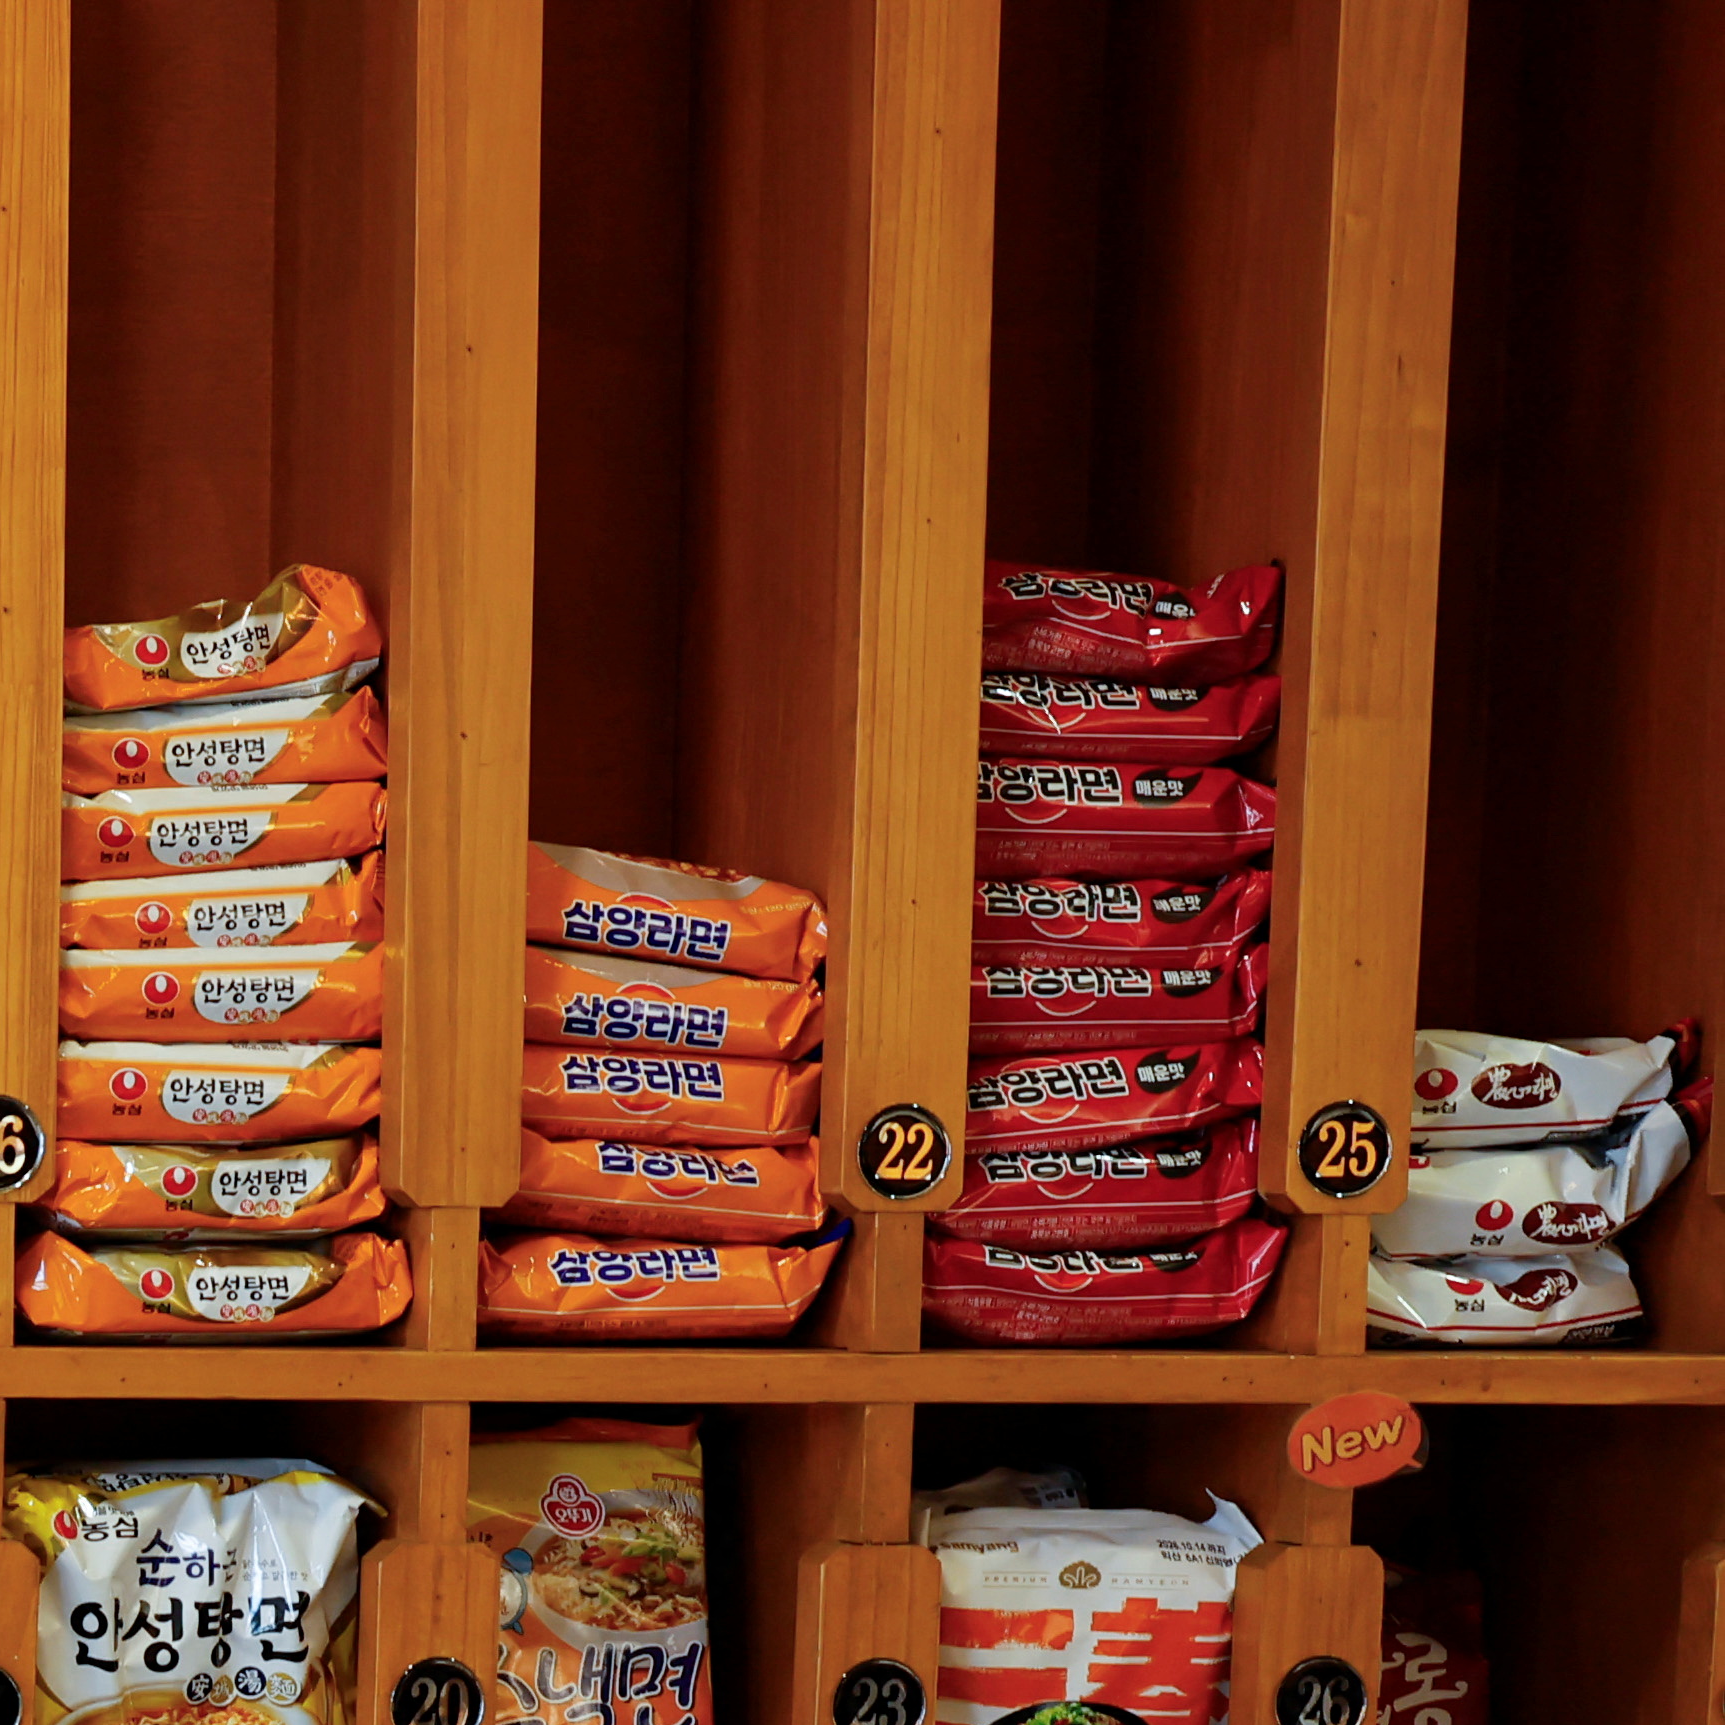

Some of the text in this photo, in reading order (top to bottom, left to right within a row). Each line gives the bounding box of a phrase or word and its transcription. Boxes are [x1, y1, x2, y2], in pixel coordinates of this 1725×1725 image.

[170, 737, 266, 767] 안성탕면
[561, 899, 732, 962] 삼양라면
[200, 974, 297, 1004] 안성탕면
[560, 992, 728, 1049] 삼양라면
[560, 1054, 724, 1102] 삼양라면
[877, 1121, 935, 1180] 22
[1317, 1121, 1377, 1178] 25
[194, 1273, 290, 1301] 안성탕면
[1301, 1415, 1405, 1472] New
[81, 1517, 138, 1542] 농심
[555, 1506, 594, 1526] 오뚜기
